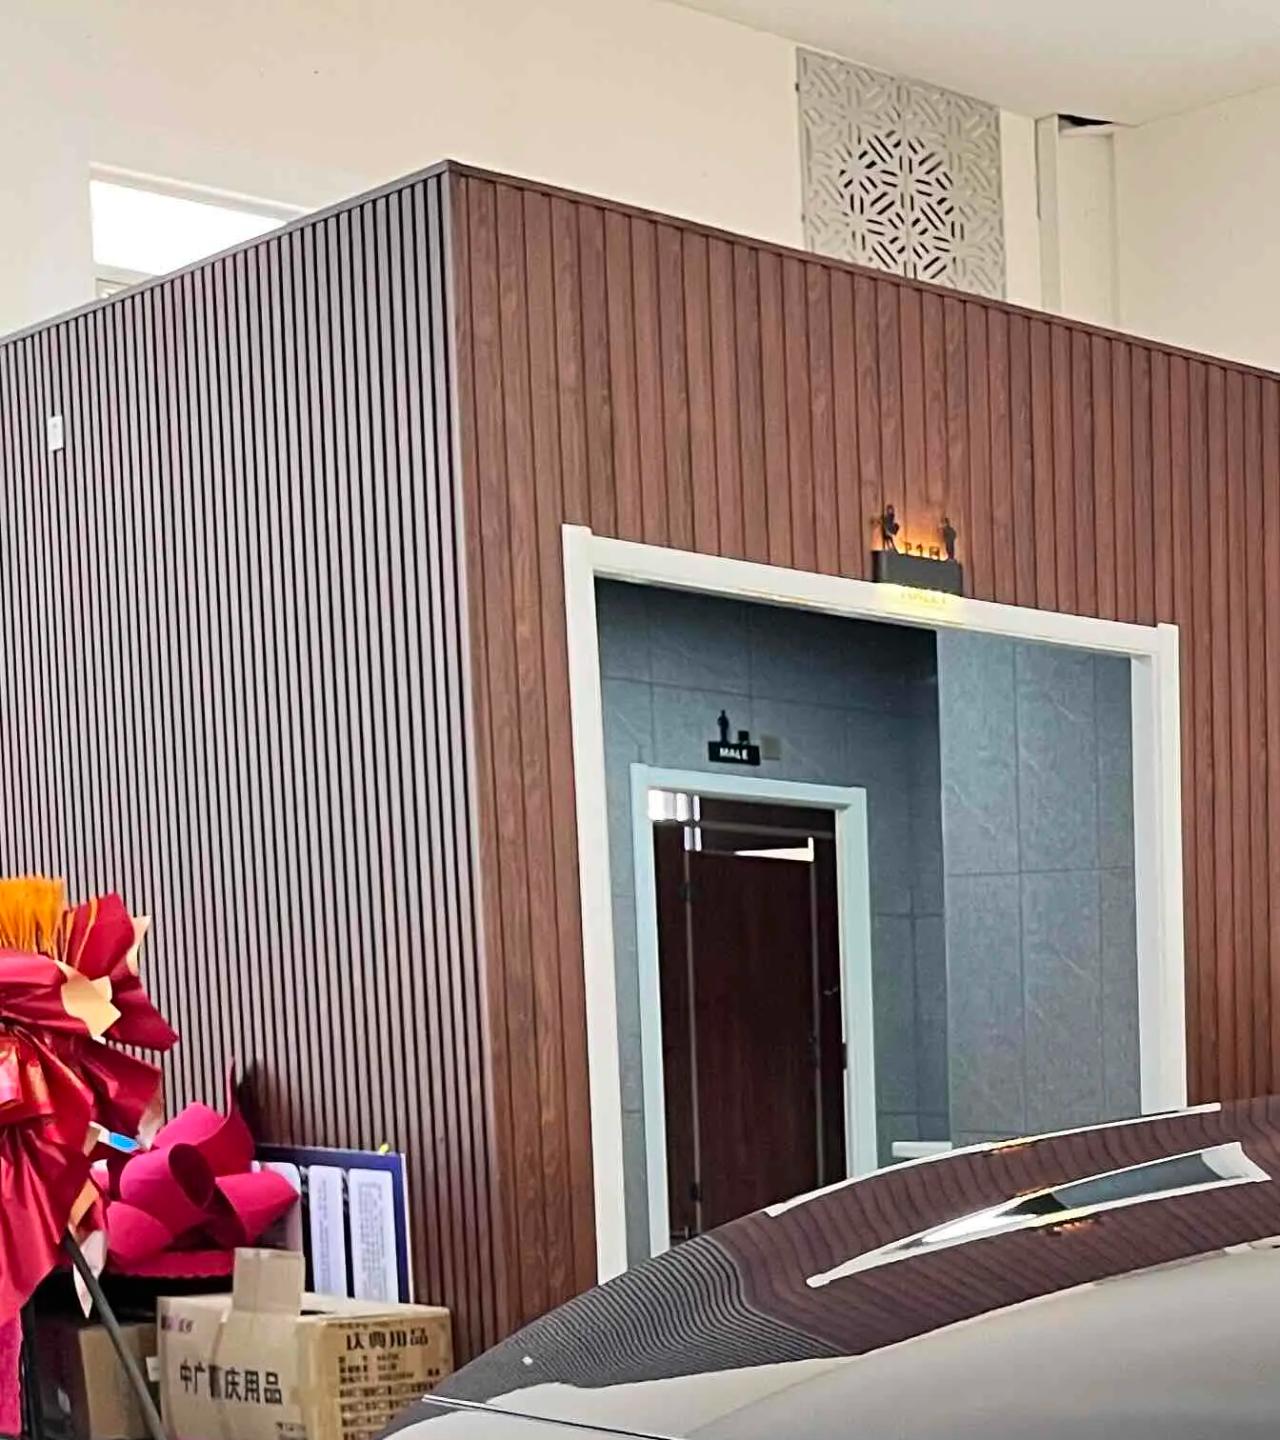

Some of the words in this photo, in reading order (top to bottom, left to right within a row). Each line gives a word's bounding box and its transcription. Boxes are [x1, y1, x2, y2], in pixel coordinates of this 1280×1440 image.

[179, 1357, 283, 1404] 中广庆用品
